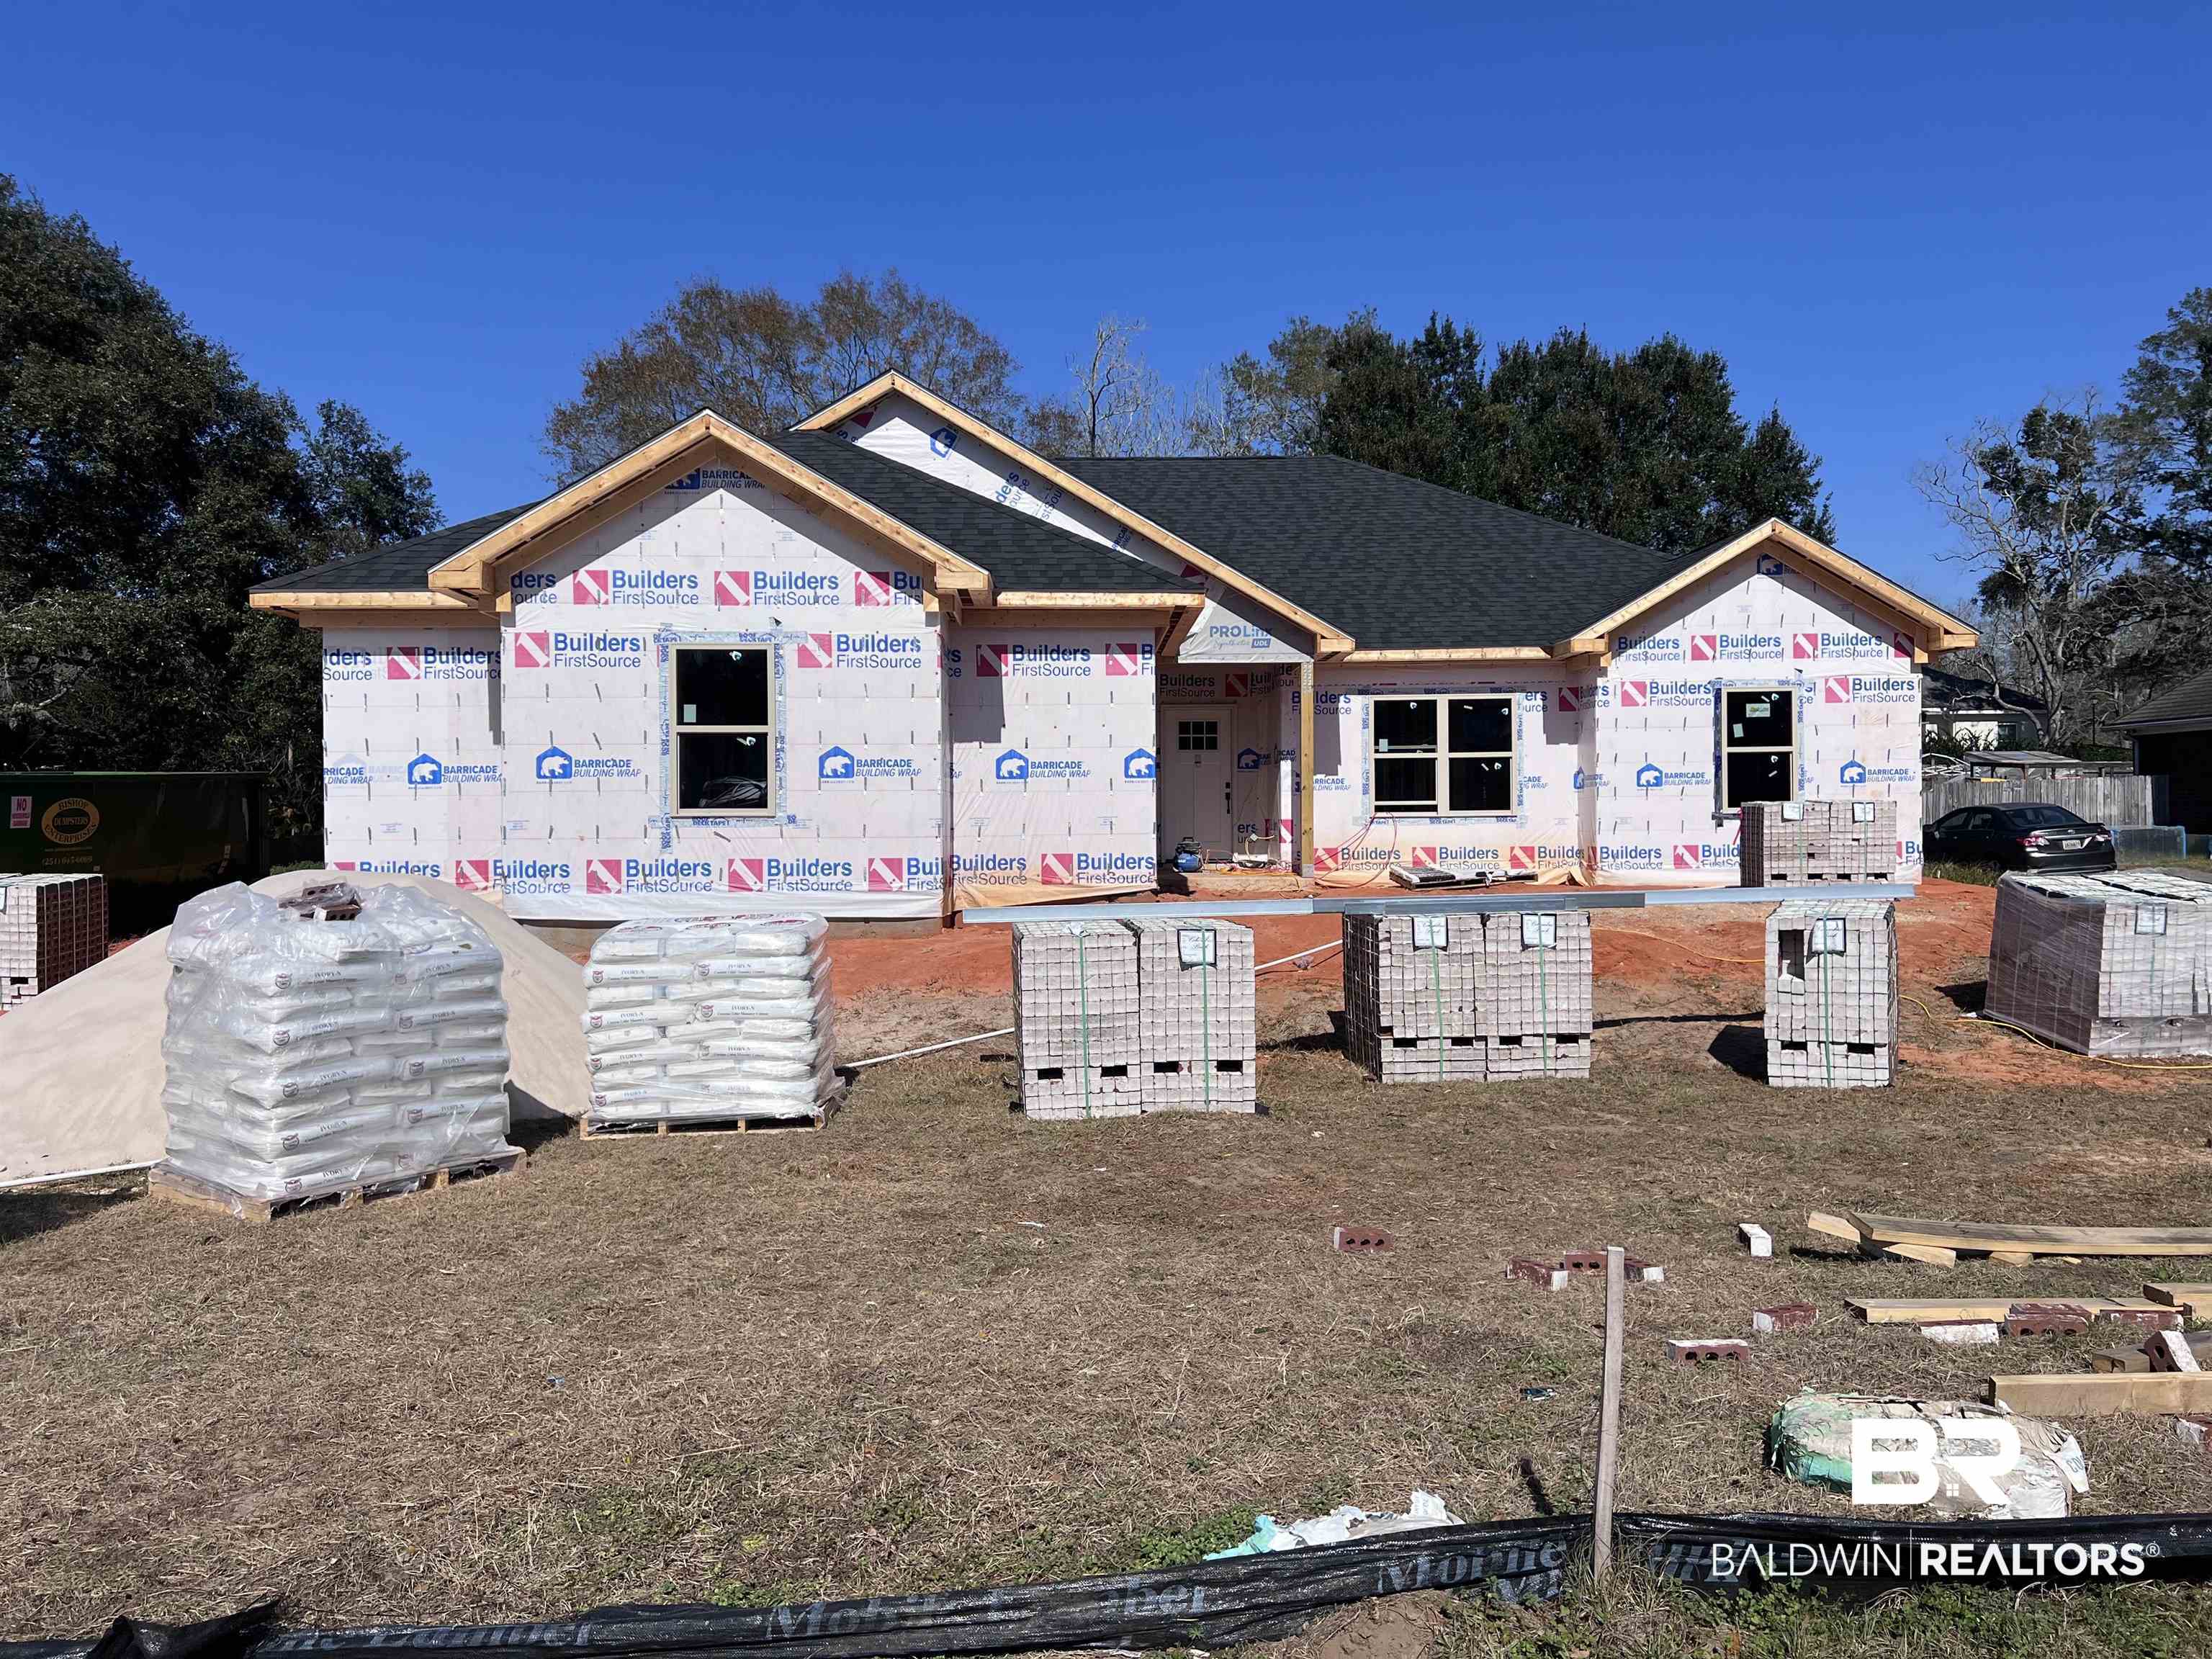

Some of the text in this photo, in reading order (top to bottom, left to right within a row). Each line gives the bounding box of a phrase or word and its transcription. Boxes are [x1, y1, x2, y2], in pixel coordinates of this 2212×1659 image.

[701, 479, 742, 489] BUILDING
[511, 570, 557, 589] ders
[612, 570, 698, 589] Builders
[754, 571, 840, 590] Builders
[612, 590, 699, 606] FirstSource
[754, 592, 840, 606] FirstSource
[554, 632, 641, 652] Builders
[837, 634, 922, 653] Builders
[1618, 636, 1681, 650] Builders
[1720, 634, 1781, 649] Builders
[1821, 633, 1883, 647] Builders
[1012, 644, 1091, 662] Builders
[1618, 651, 1681, 662] FirstSource
[1720, 649, 1782, 661] FirstSource
[1821, 647, 1884, 658] FirstSource
[554, 653, 642, 668] FirstSource
[837, 654, 922, 669] FirstSource
[1012, 662, 1091, 677] FirstSource
[1160, 674, 1215, 687] Builders
[1650, 680, 1712, 695] Builders
[1853, 678, 1915, 692] Builders
[1160, 688, 1215, 698] FirstSource
[1853, 692, 1916, 703] FirstSource
[1650, 696, 1712, 707] FirstSource
[443, 765, 498, 774] BARRICADE
[574, 759, 632, 768] BARRICADE
[856, 758, 912, 768] BARRICADE
[1030, 760, 1083, 770] BARRICADE
[442, 774, 483, 783] BUILDING
[573, 768, 642, 778] BUILDING WRAP
[855, 768, 922, 778] BUILDING WRAP
[1029, 769, 1091, 779] BUILDING WRAP
[1867, 775, 1897, 783] BUILDING
[17, 797, 27, 812] NO
[1341, 847, 1401, 860] Builders
[1439, 847, 1499, 860] Builders
[1599, 845, 1663, 860] Builders
[626, 858, 712, 878] Builders
[768, 858, 853, 877] Builders
[950, 854, 1027, 871] Builders
[1077, 853, 1156, 871] Builders
[1341, 860, 1401, 871] FirstSource
[626, 878, 713, 894] FirstSource
[768, 878, 853, 892] FirstSource
[950, 873, 1028, 886] FirstSource
